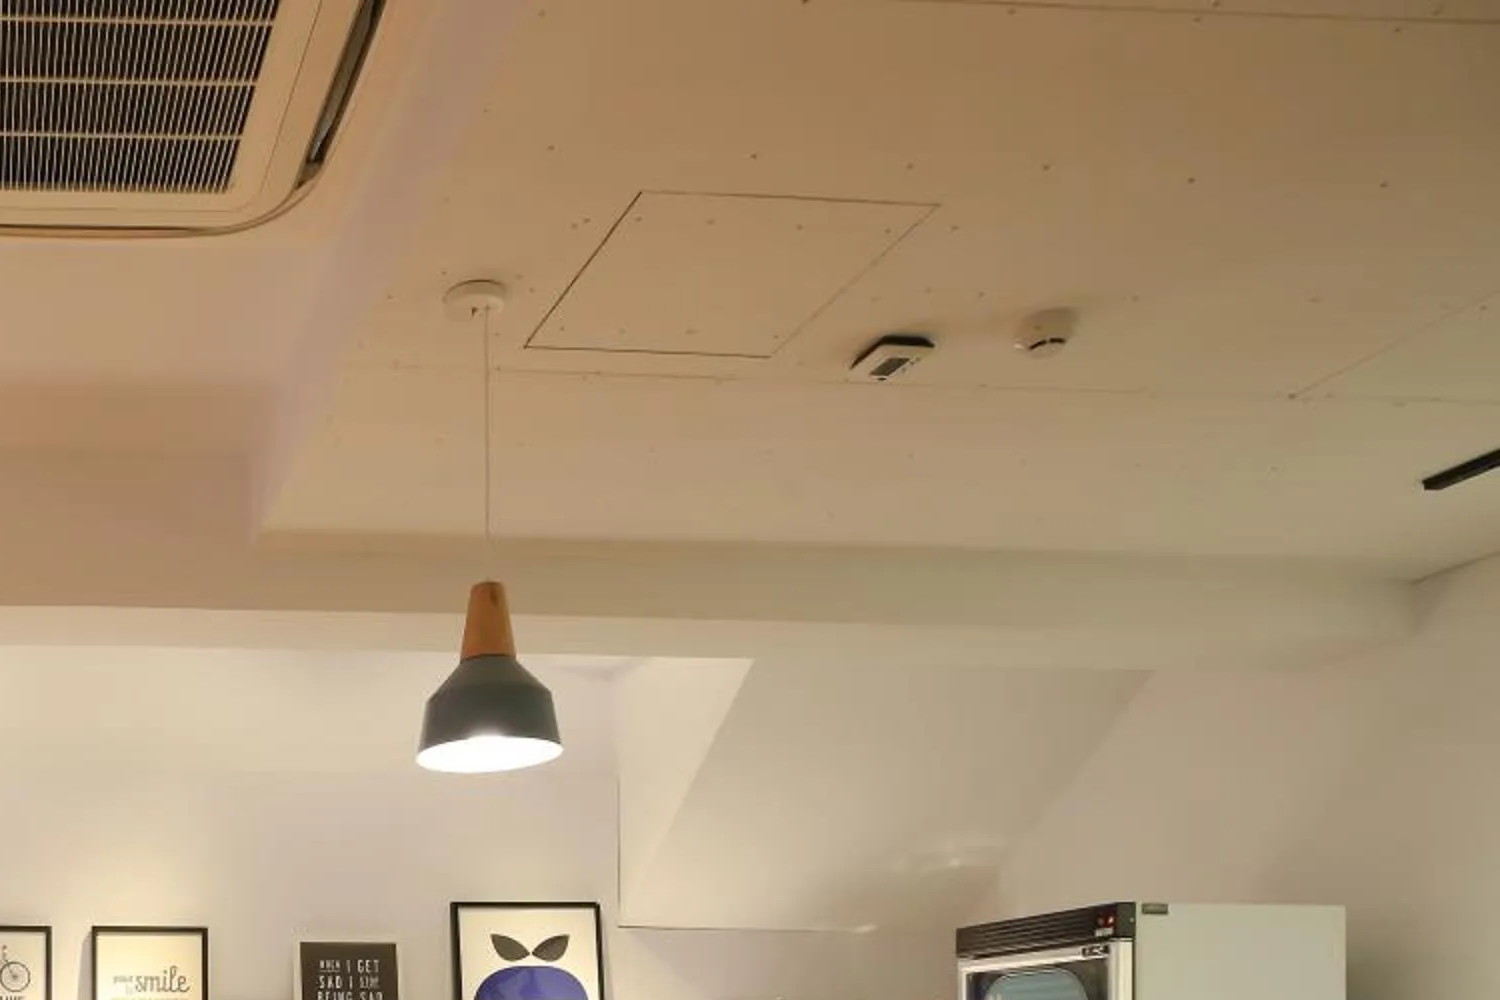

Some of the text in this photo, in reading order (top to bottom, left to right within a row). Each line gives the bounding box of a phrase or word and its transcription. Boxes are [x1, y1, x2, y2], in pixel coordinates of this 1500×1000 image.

[357, 959, 380, 974] GET
[135, 965, 190, 992] smile
[319, 975, 343, 989] SAD
